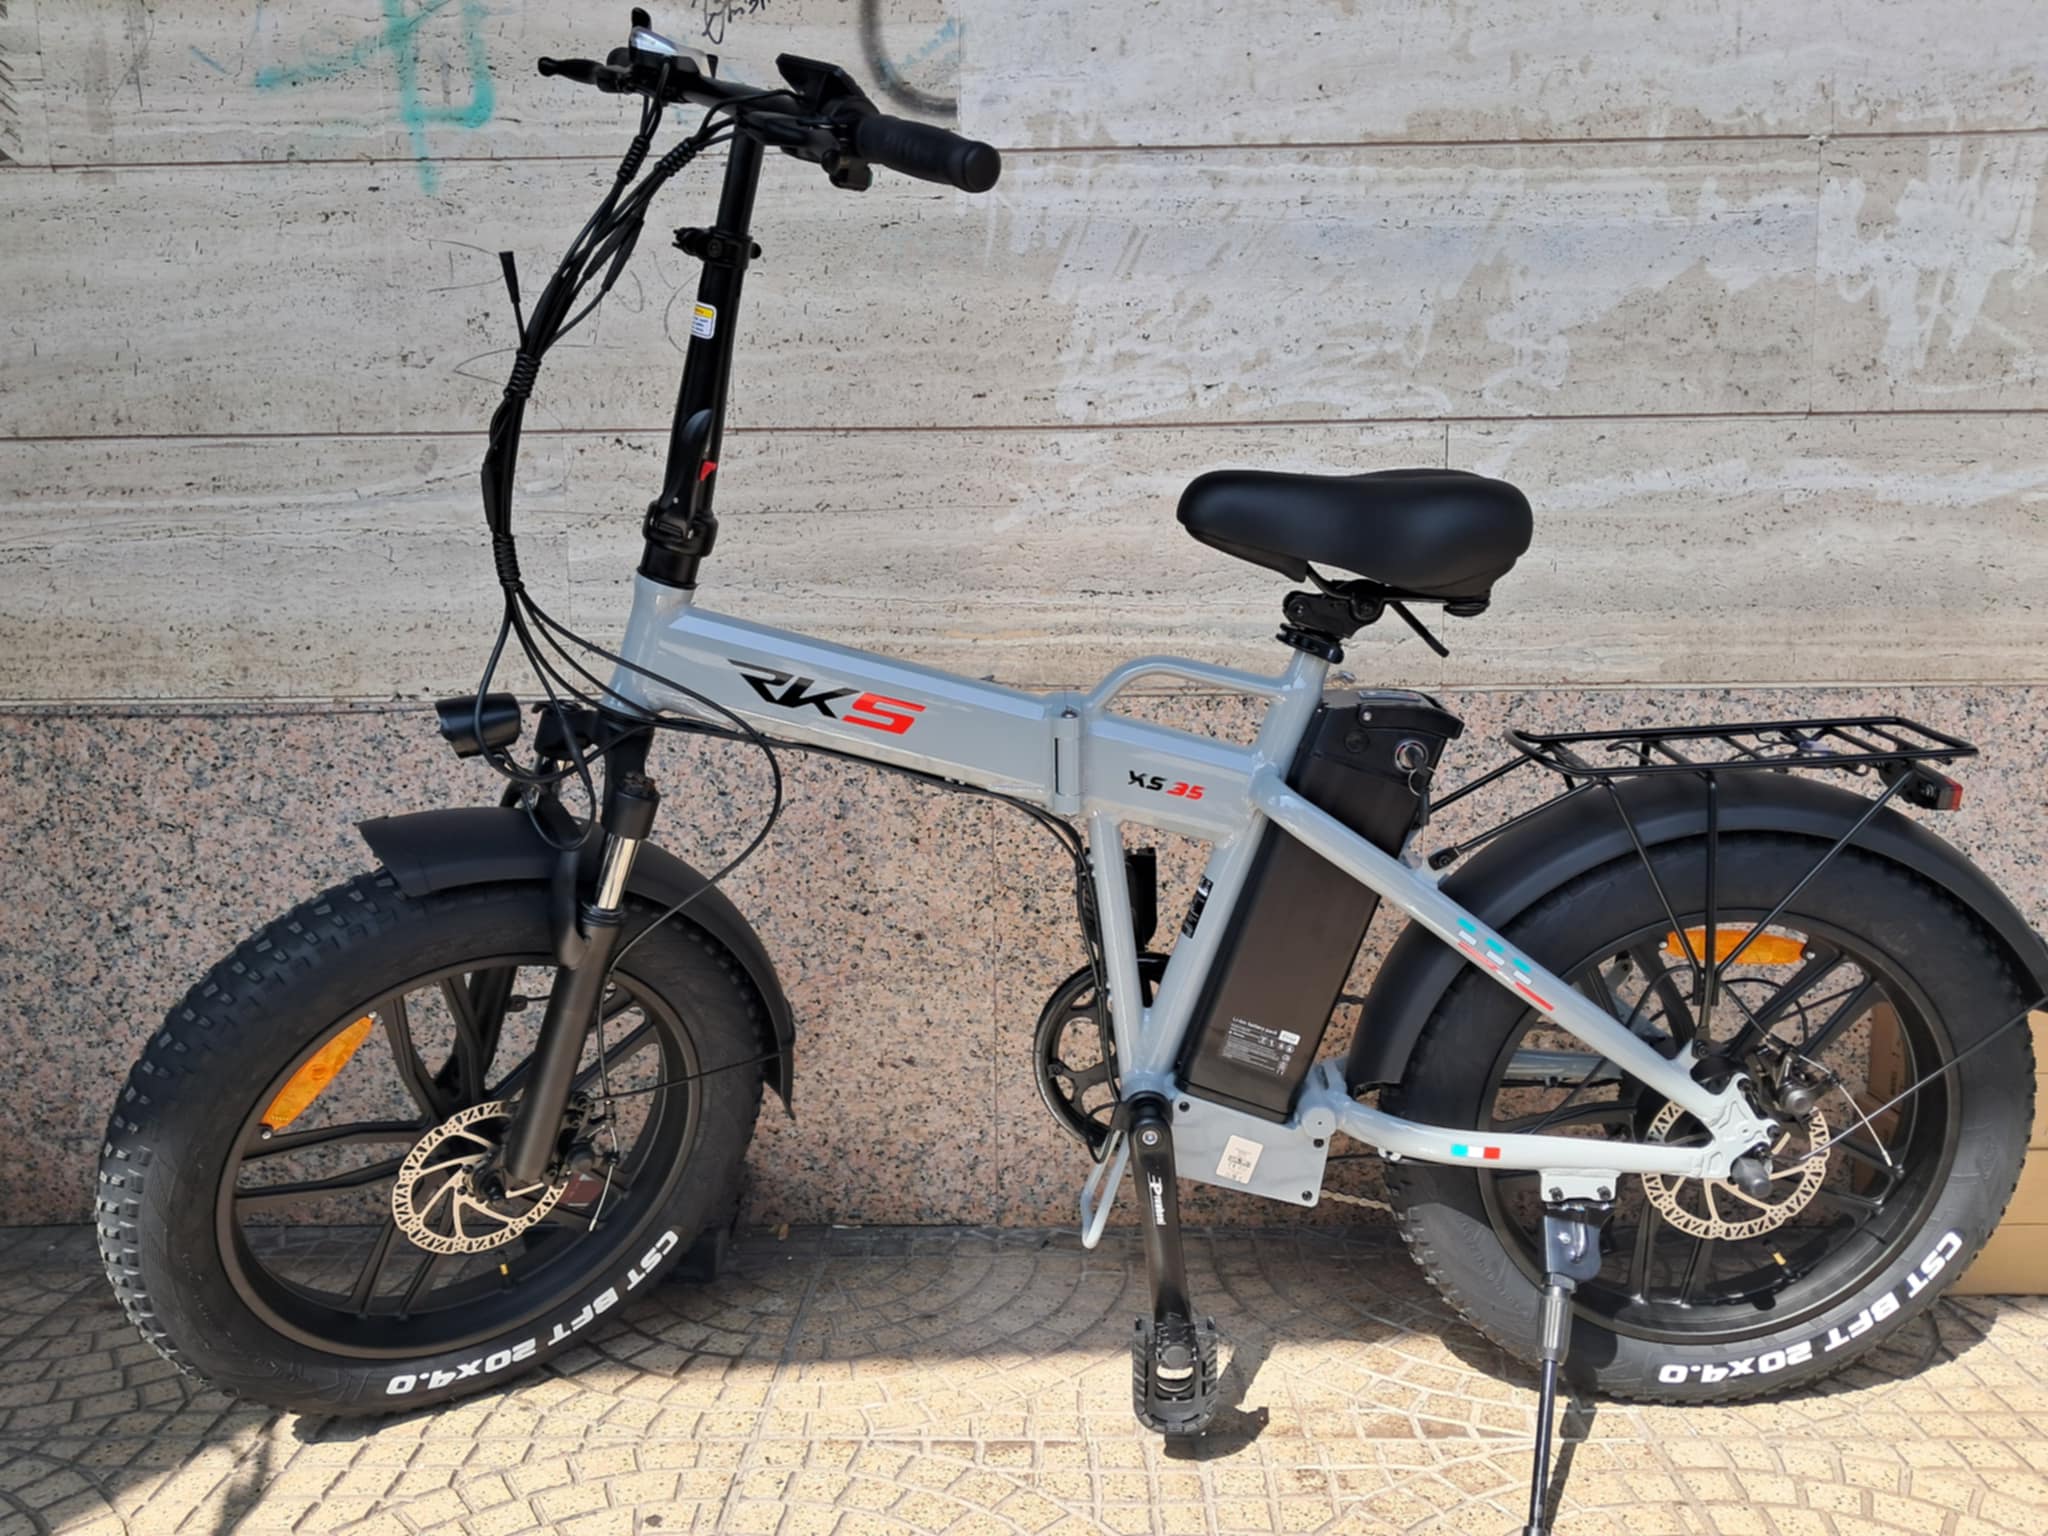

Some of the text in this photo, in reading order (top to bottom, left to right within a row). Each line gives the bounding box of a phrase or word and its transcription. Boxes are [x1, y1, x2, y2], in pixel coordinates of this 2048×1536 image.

[727, 658, 927, 735] RKS
[627, 1230, 679, 1291] CST
[1906, 1231, 1963, 1298] CST
[547, 1287, 619, 1347] BFT
[1824, 1292, 1900, 1352] BFT
